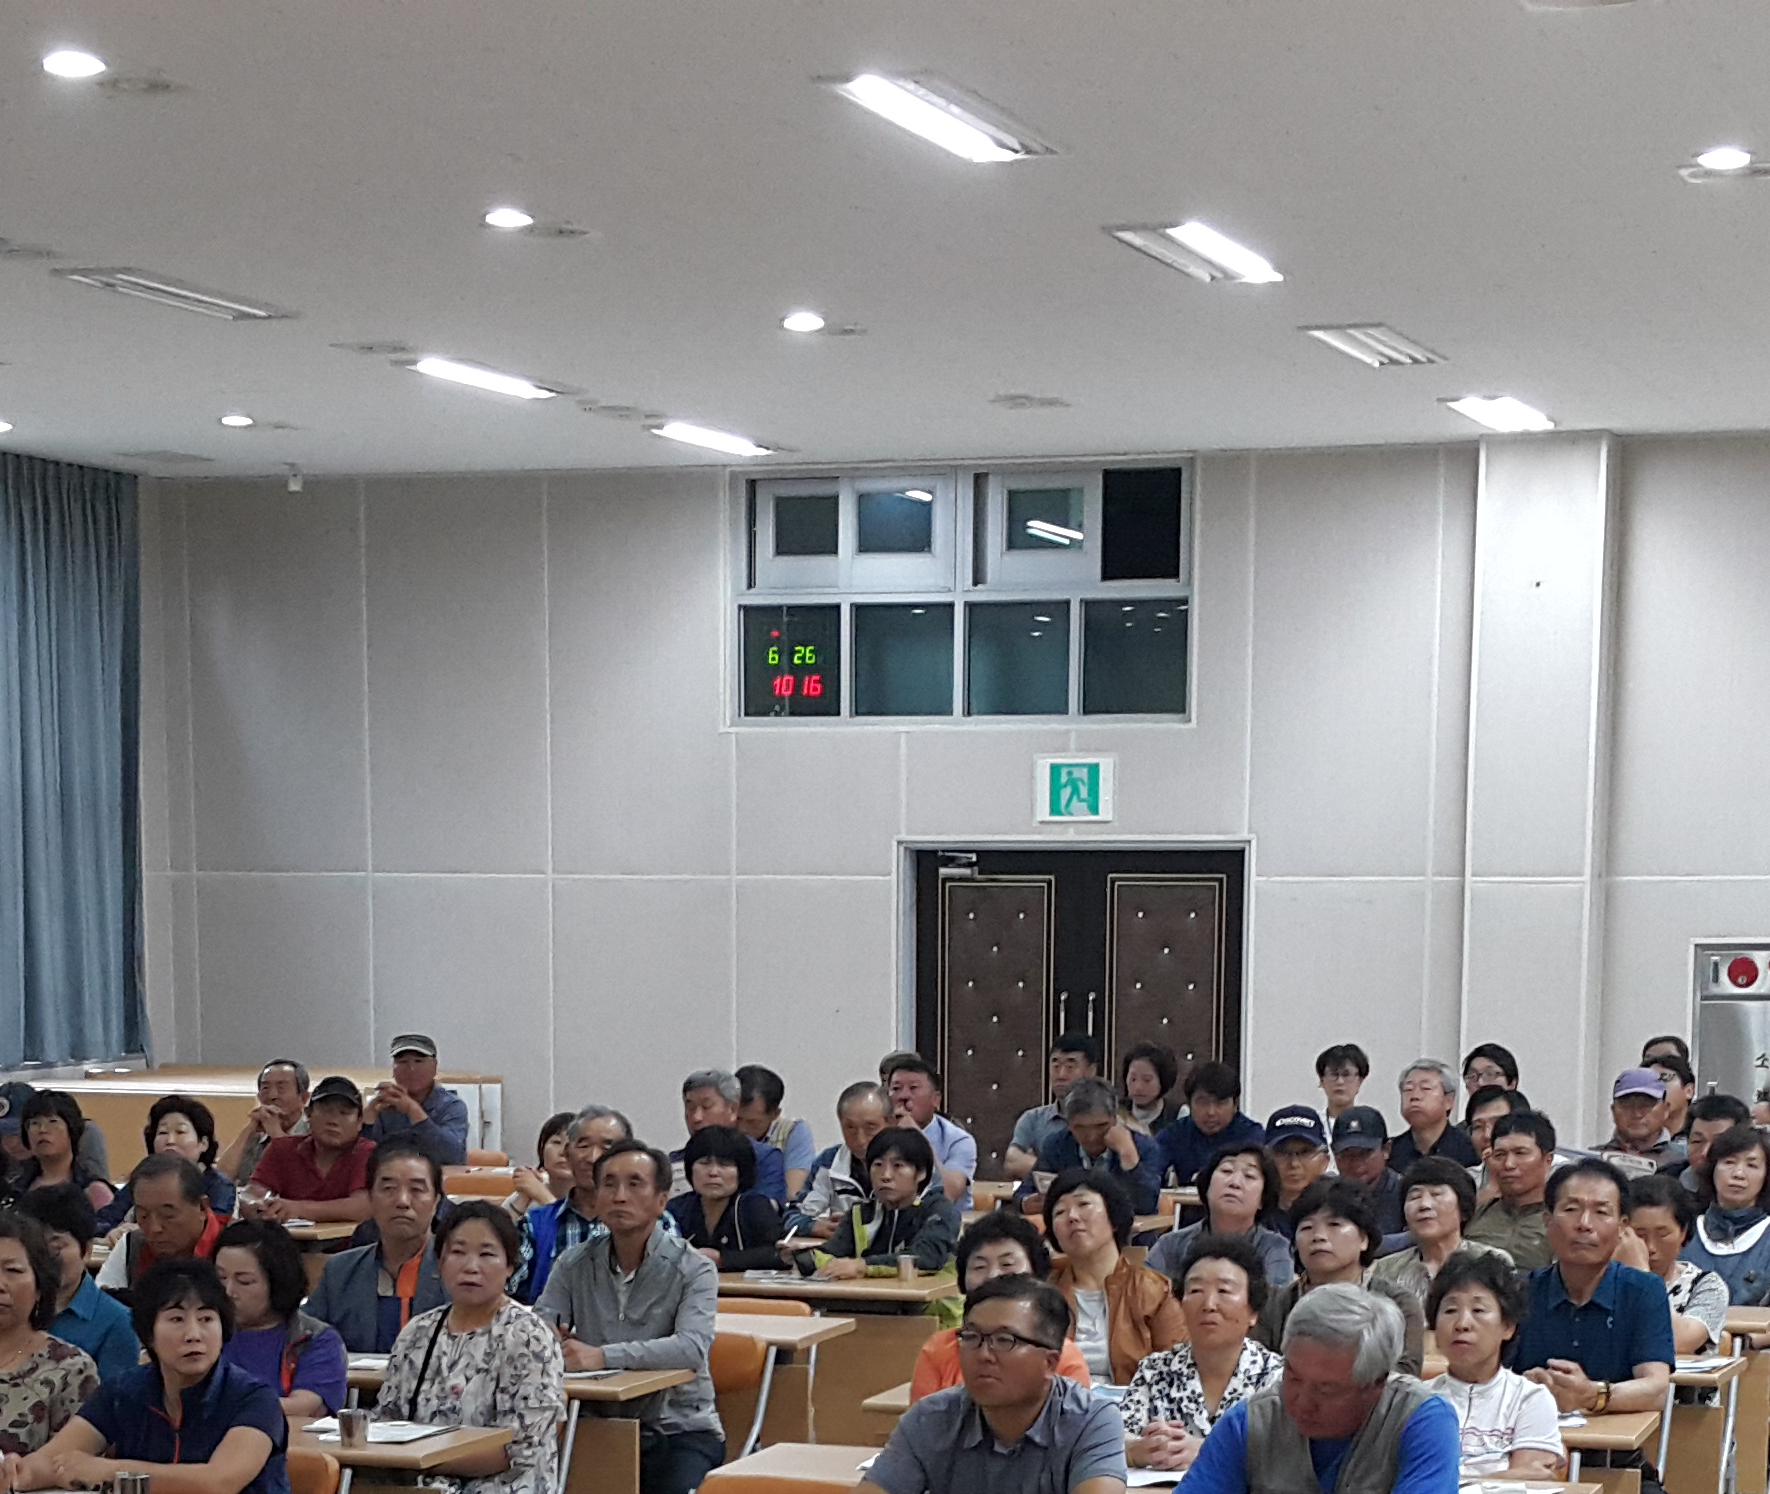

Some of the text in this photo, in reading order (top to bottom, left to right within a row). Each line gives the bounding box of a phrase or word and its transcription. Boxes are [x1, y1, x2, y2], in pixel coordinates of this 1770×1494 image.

[768, 646, 816, 665] 6 26
[773, 674, 823, 697] 10 16
